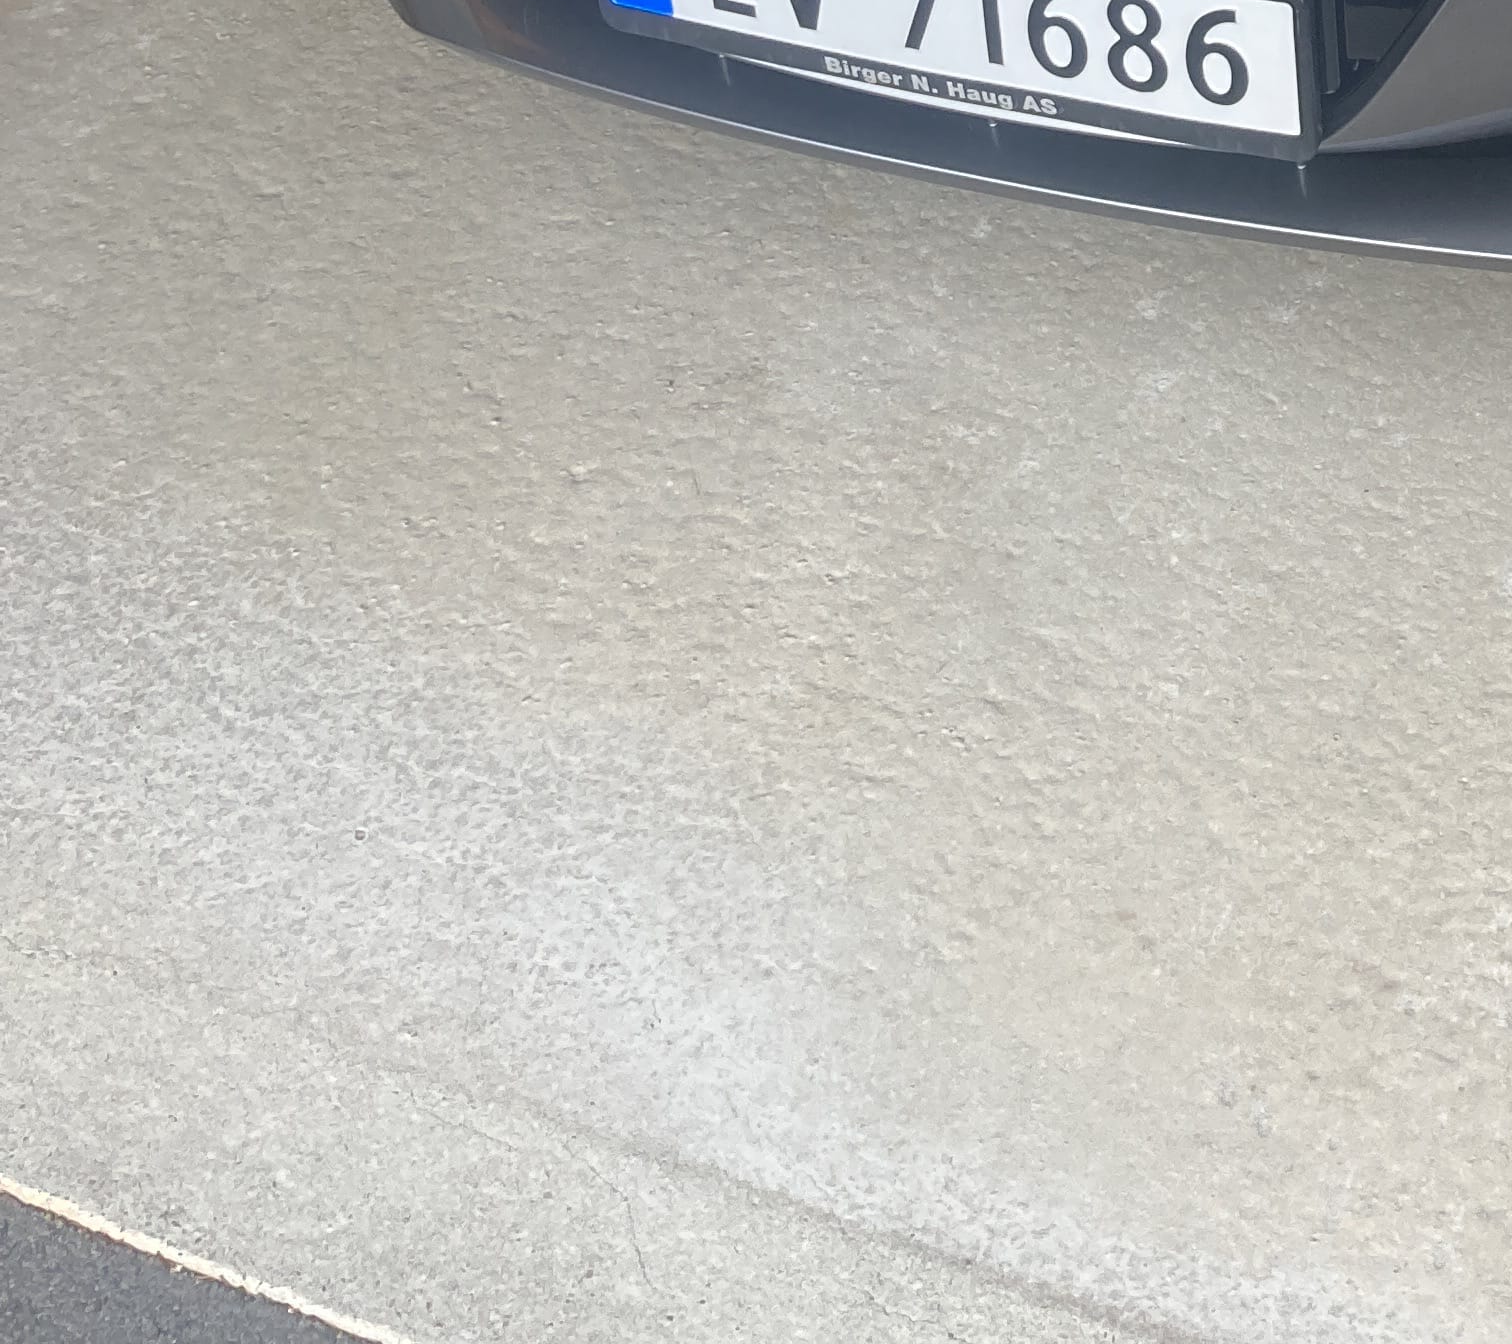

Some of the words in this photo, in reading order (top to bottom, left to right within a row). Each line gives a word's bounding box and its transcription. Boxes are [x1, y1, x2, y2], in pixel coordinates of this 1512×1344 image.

[823, 56, 903, 86] Birger
[911, 74, 939, 94] N.
[946, 80, 1014, 110] Haug
[1023, 96, 1058, 115] AS
